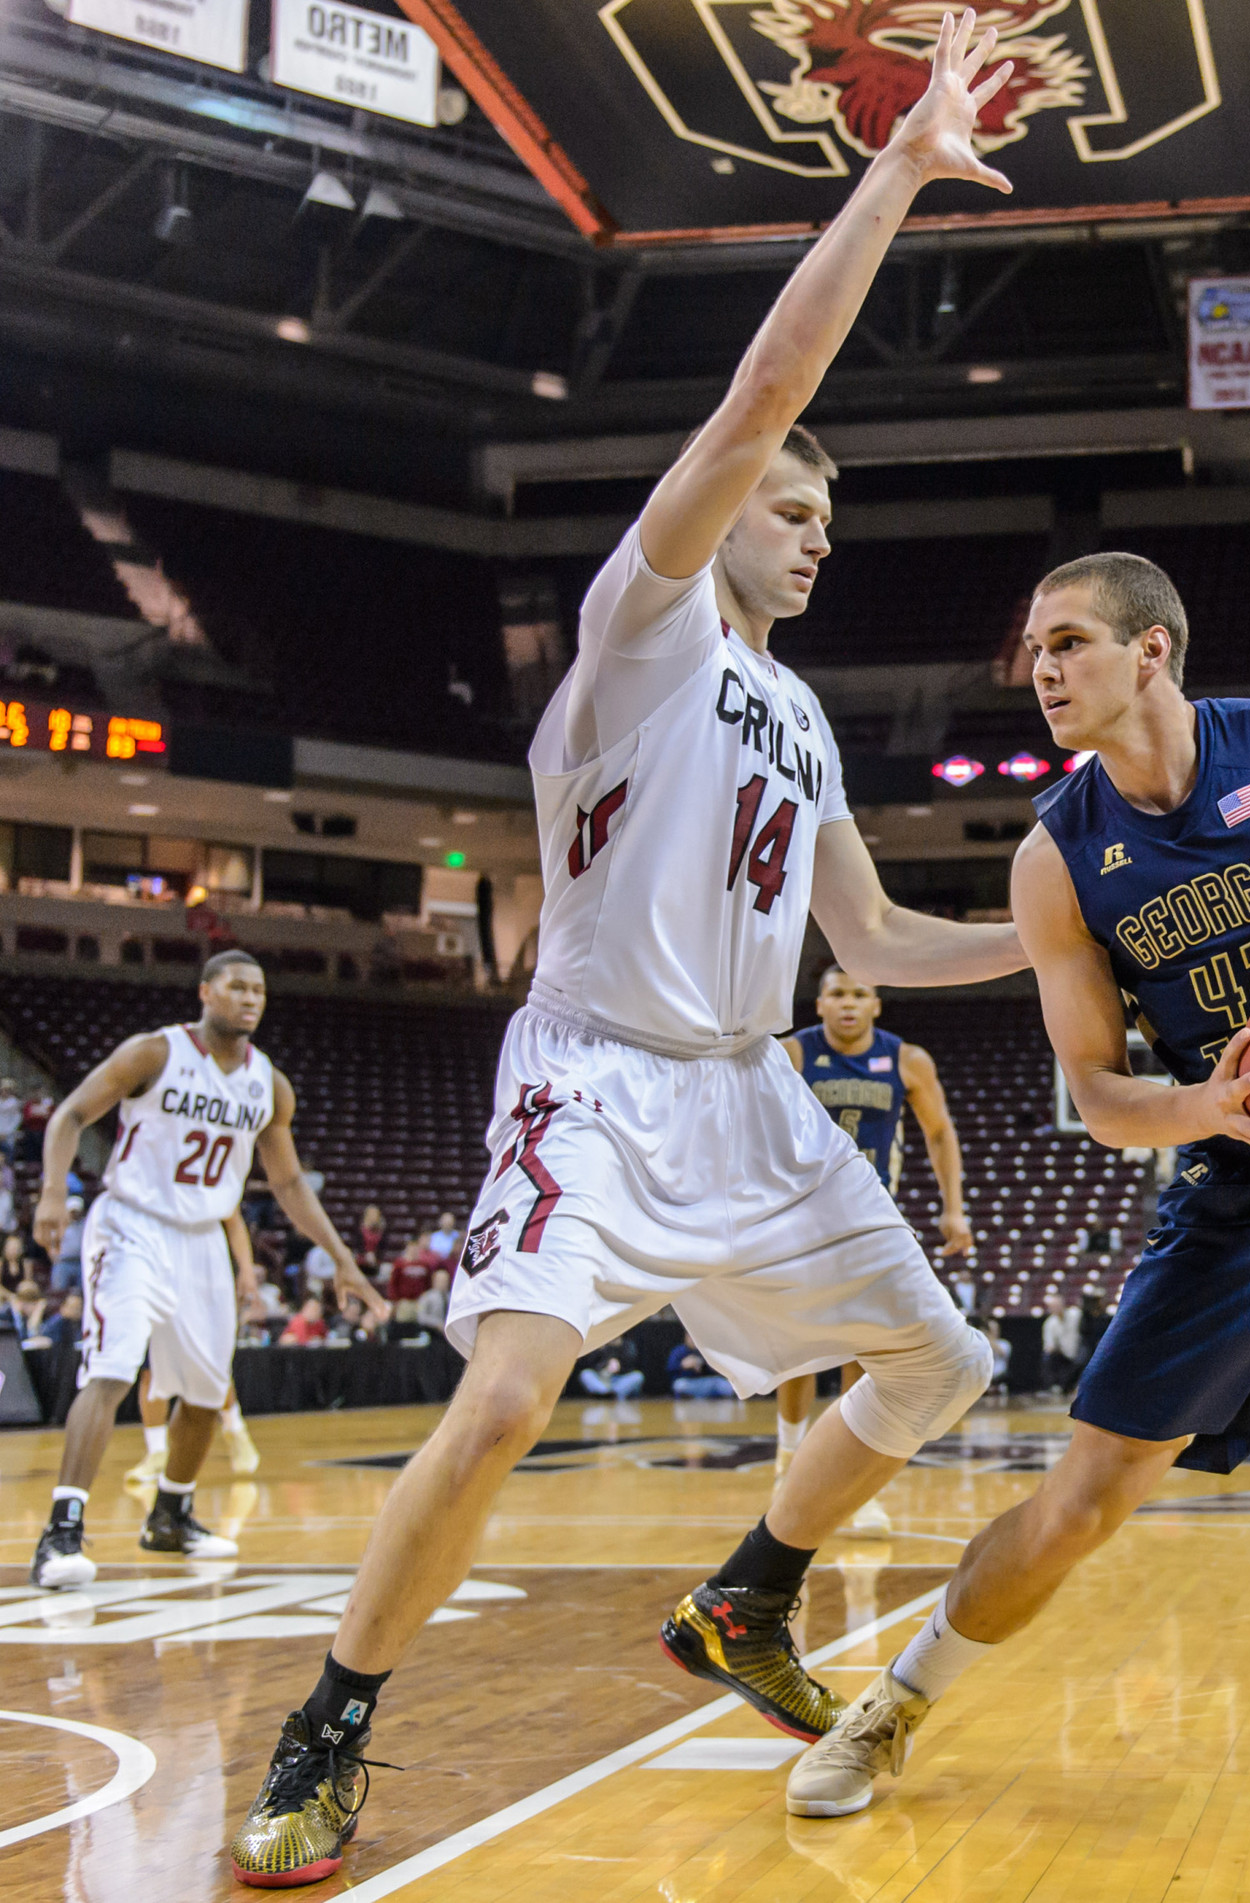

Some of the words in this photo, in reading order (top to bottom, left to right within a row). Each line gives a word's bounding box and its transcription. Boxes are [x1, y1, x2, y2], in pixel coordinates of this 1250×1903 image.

[726, 772, 799, 916] 14
[1100, 856, 1134, 876] RUSSELL
[174, 1130, 235, 1187] 20
